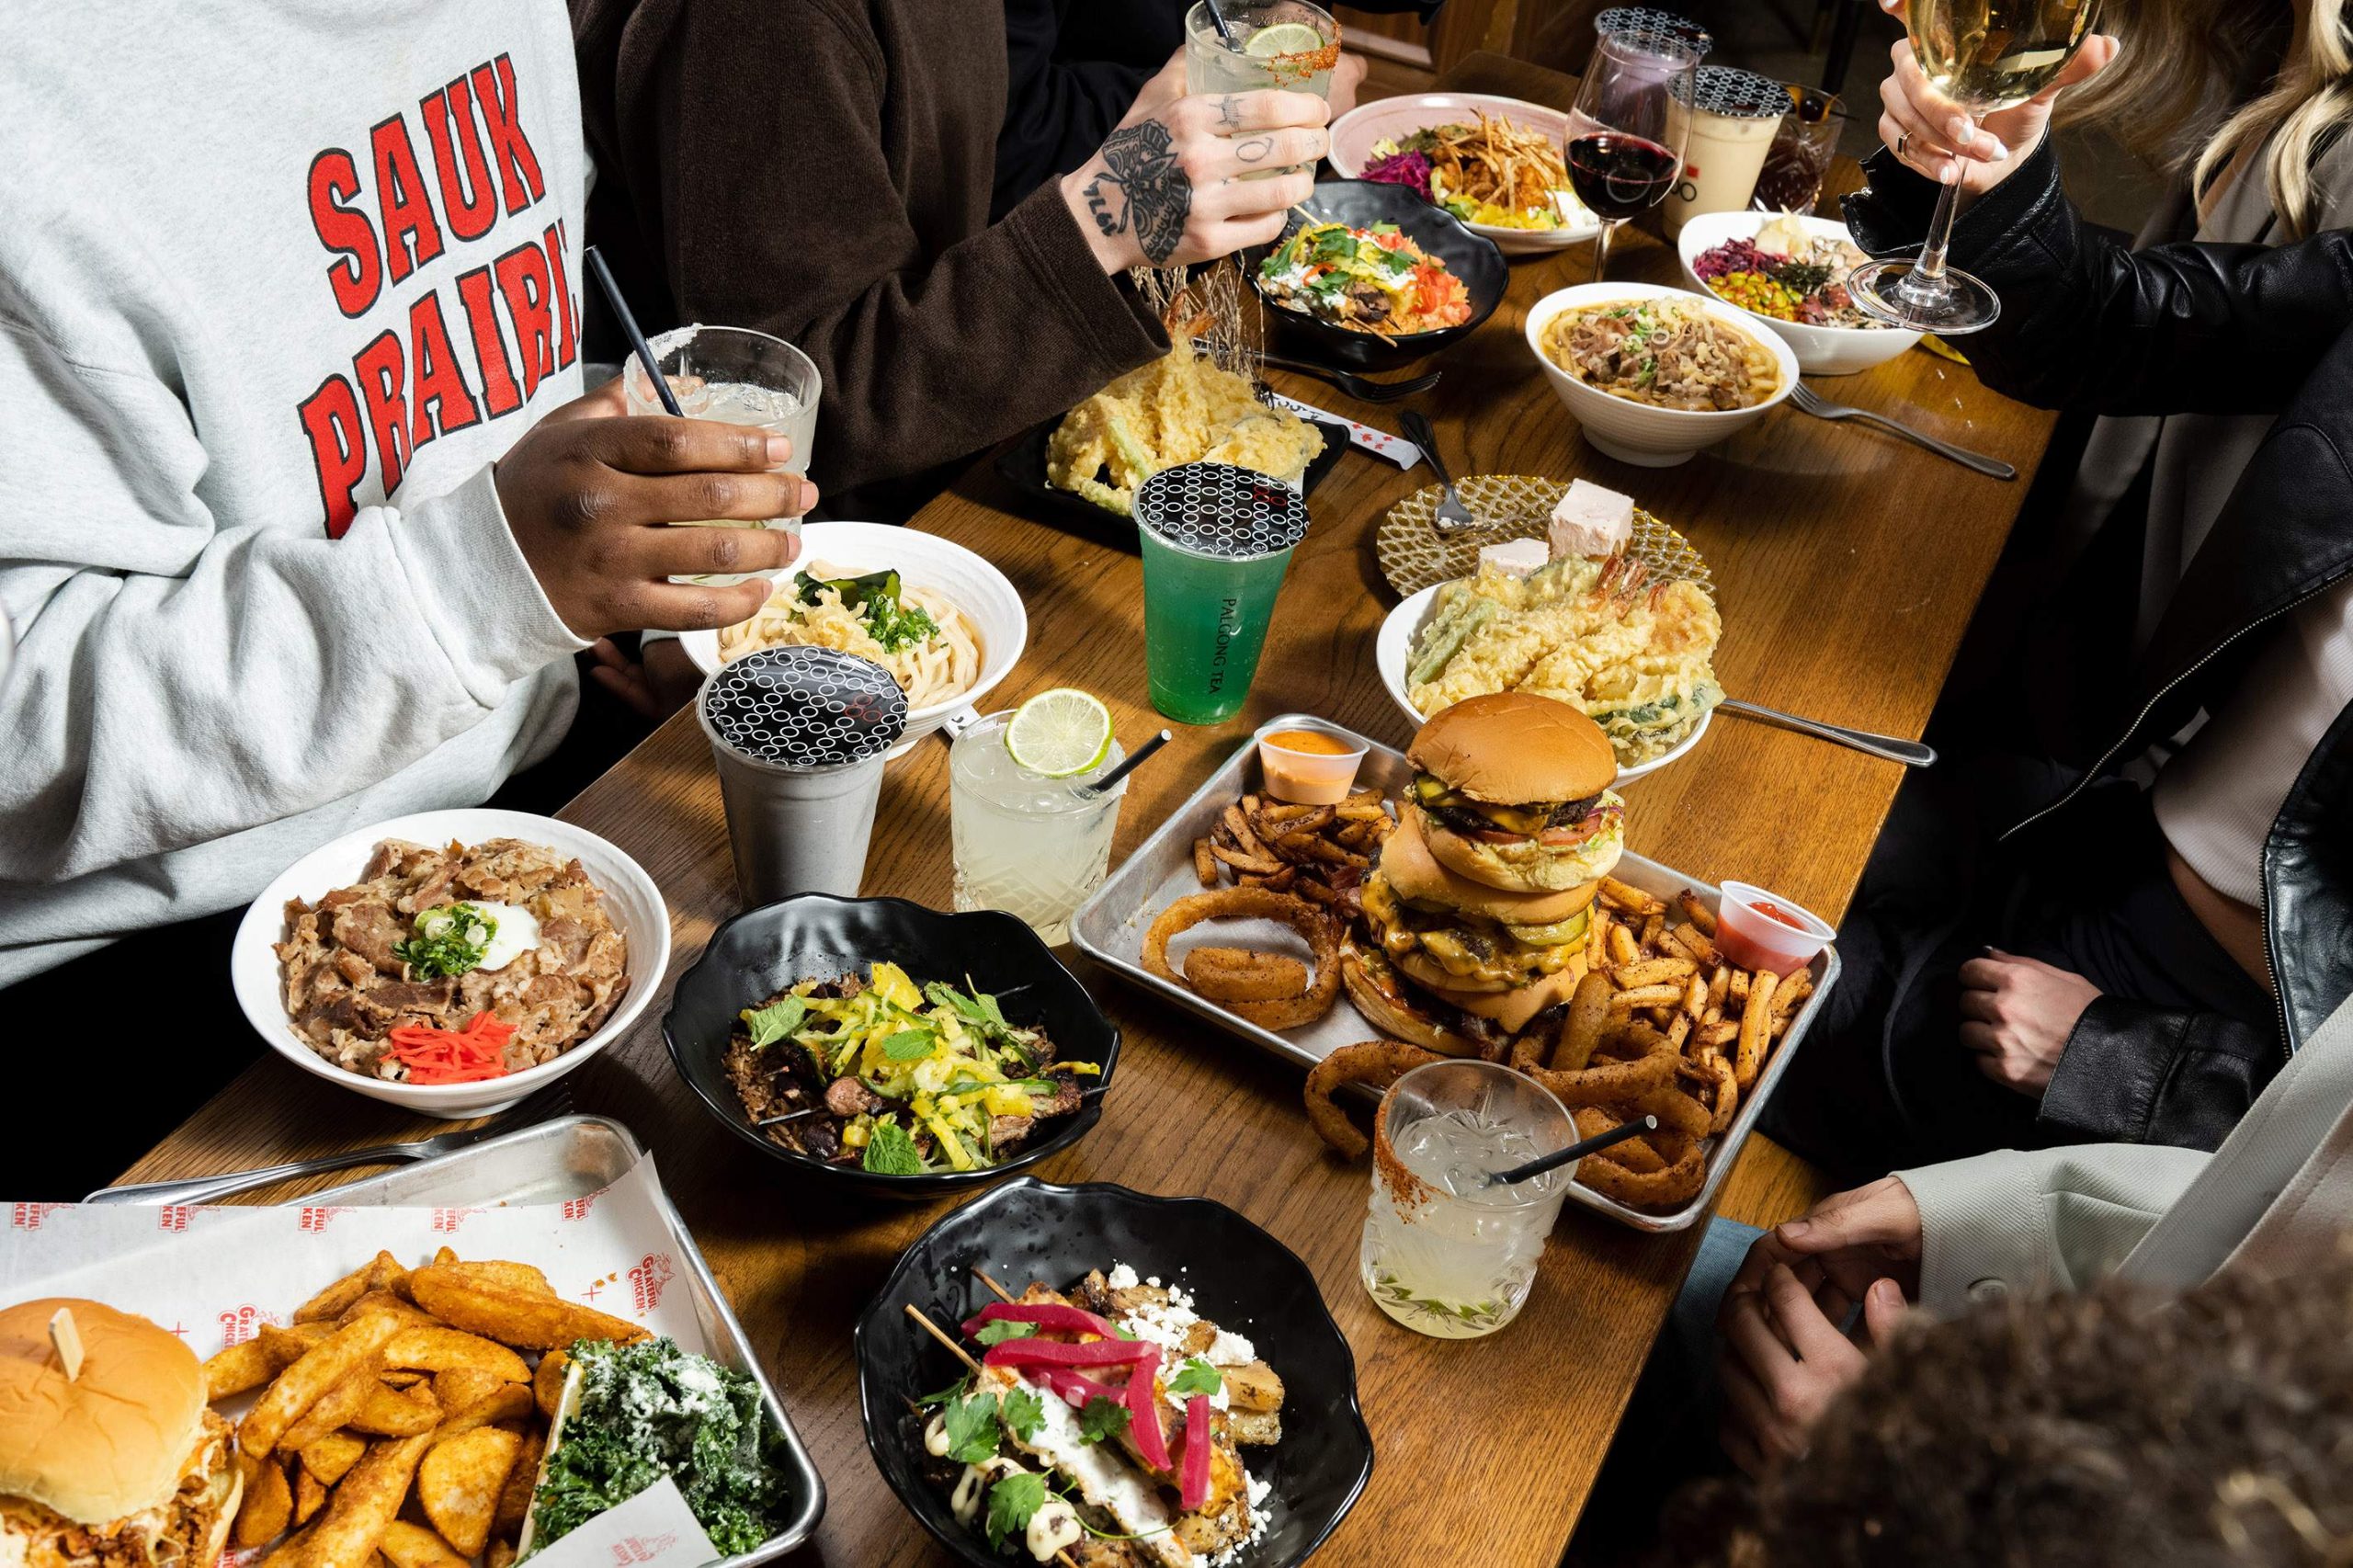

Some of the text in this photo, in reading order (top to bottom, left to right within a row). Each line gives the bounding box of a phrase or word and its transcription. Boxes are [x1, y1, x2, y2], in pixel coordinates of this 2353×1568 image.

[307, 51, 546, 319] SAUK
[296, 217, 581, 540] PRAIRI
[1209, 598, 1237, 694] PALGONG TEA
[628, 1268, 645, 1310] CHICKEN
[642, 1256, 657, 1309] GRATEFUL
[220, 1312, 237, 1347] CHICK
